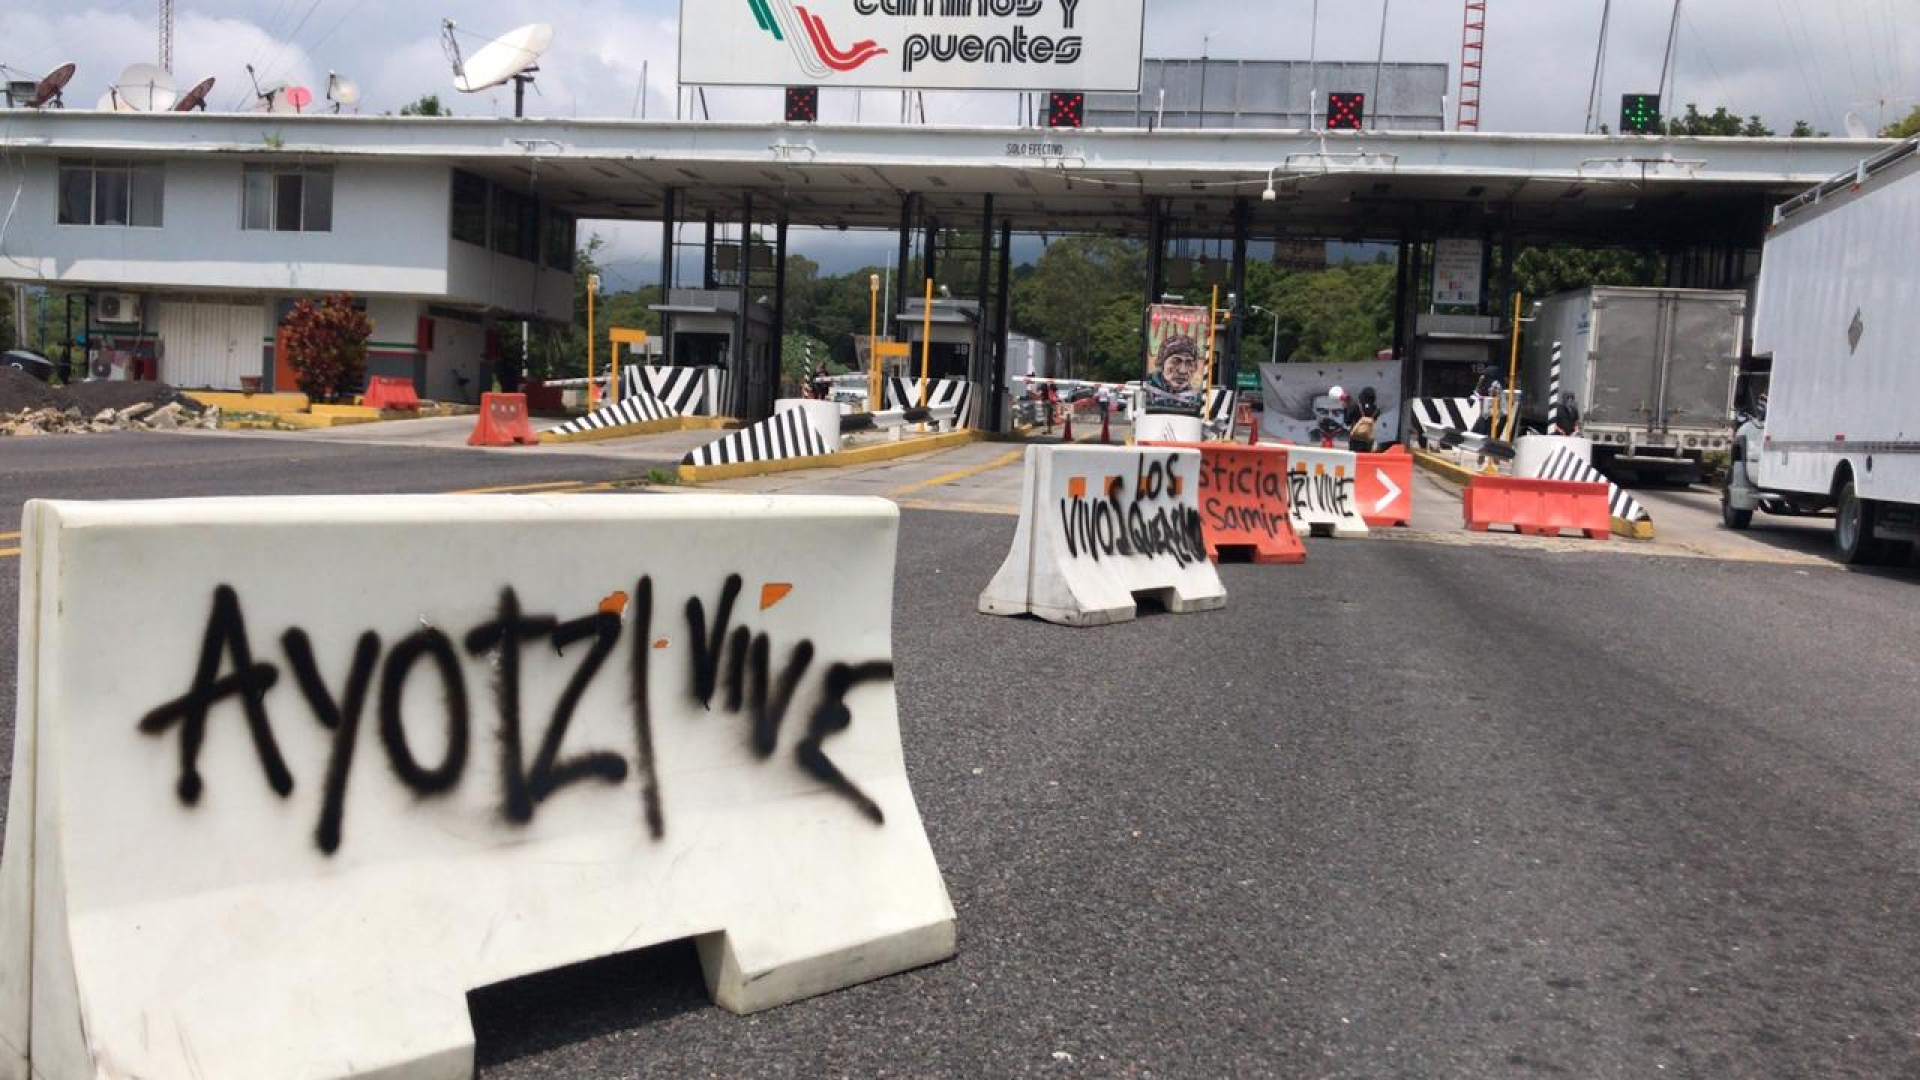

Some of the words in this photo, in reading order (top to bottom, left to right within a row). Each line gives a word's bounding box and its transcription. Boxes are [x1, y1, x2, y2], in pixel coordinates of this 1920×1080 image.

[903, 25, 1082, 72] puentes
[1007, 143, 1026, 156] SOLO
[1135, 452, 1179, 501] LOS
[1199, 456, 1282, 502] sticia
[1287, 468, 1315, 520] TZI
[1314, 474, 1355, 517] VIVE
[137, 574, 665, 856] AYOTZI
